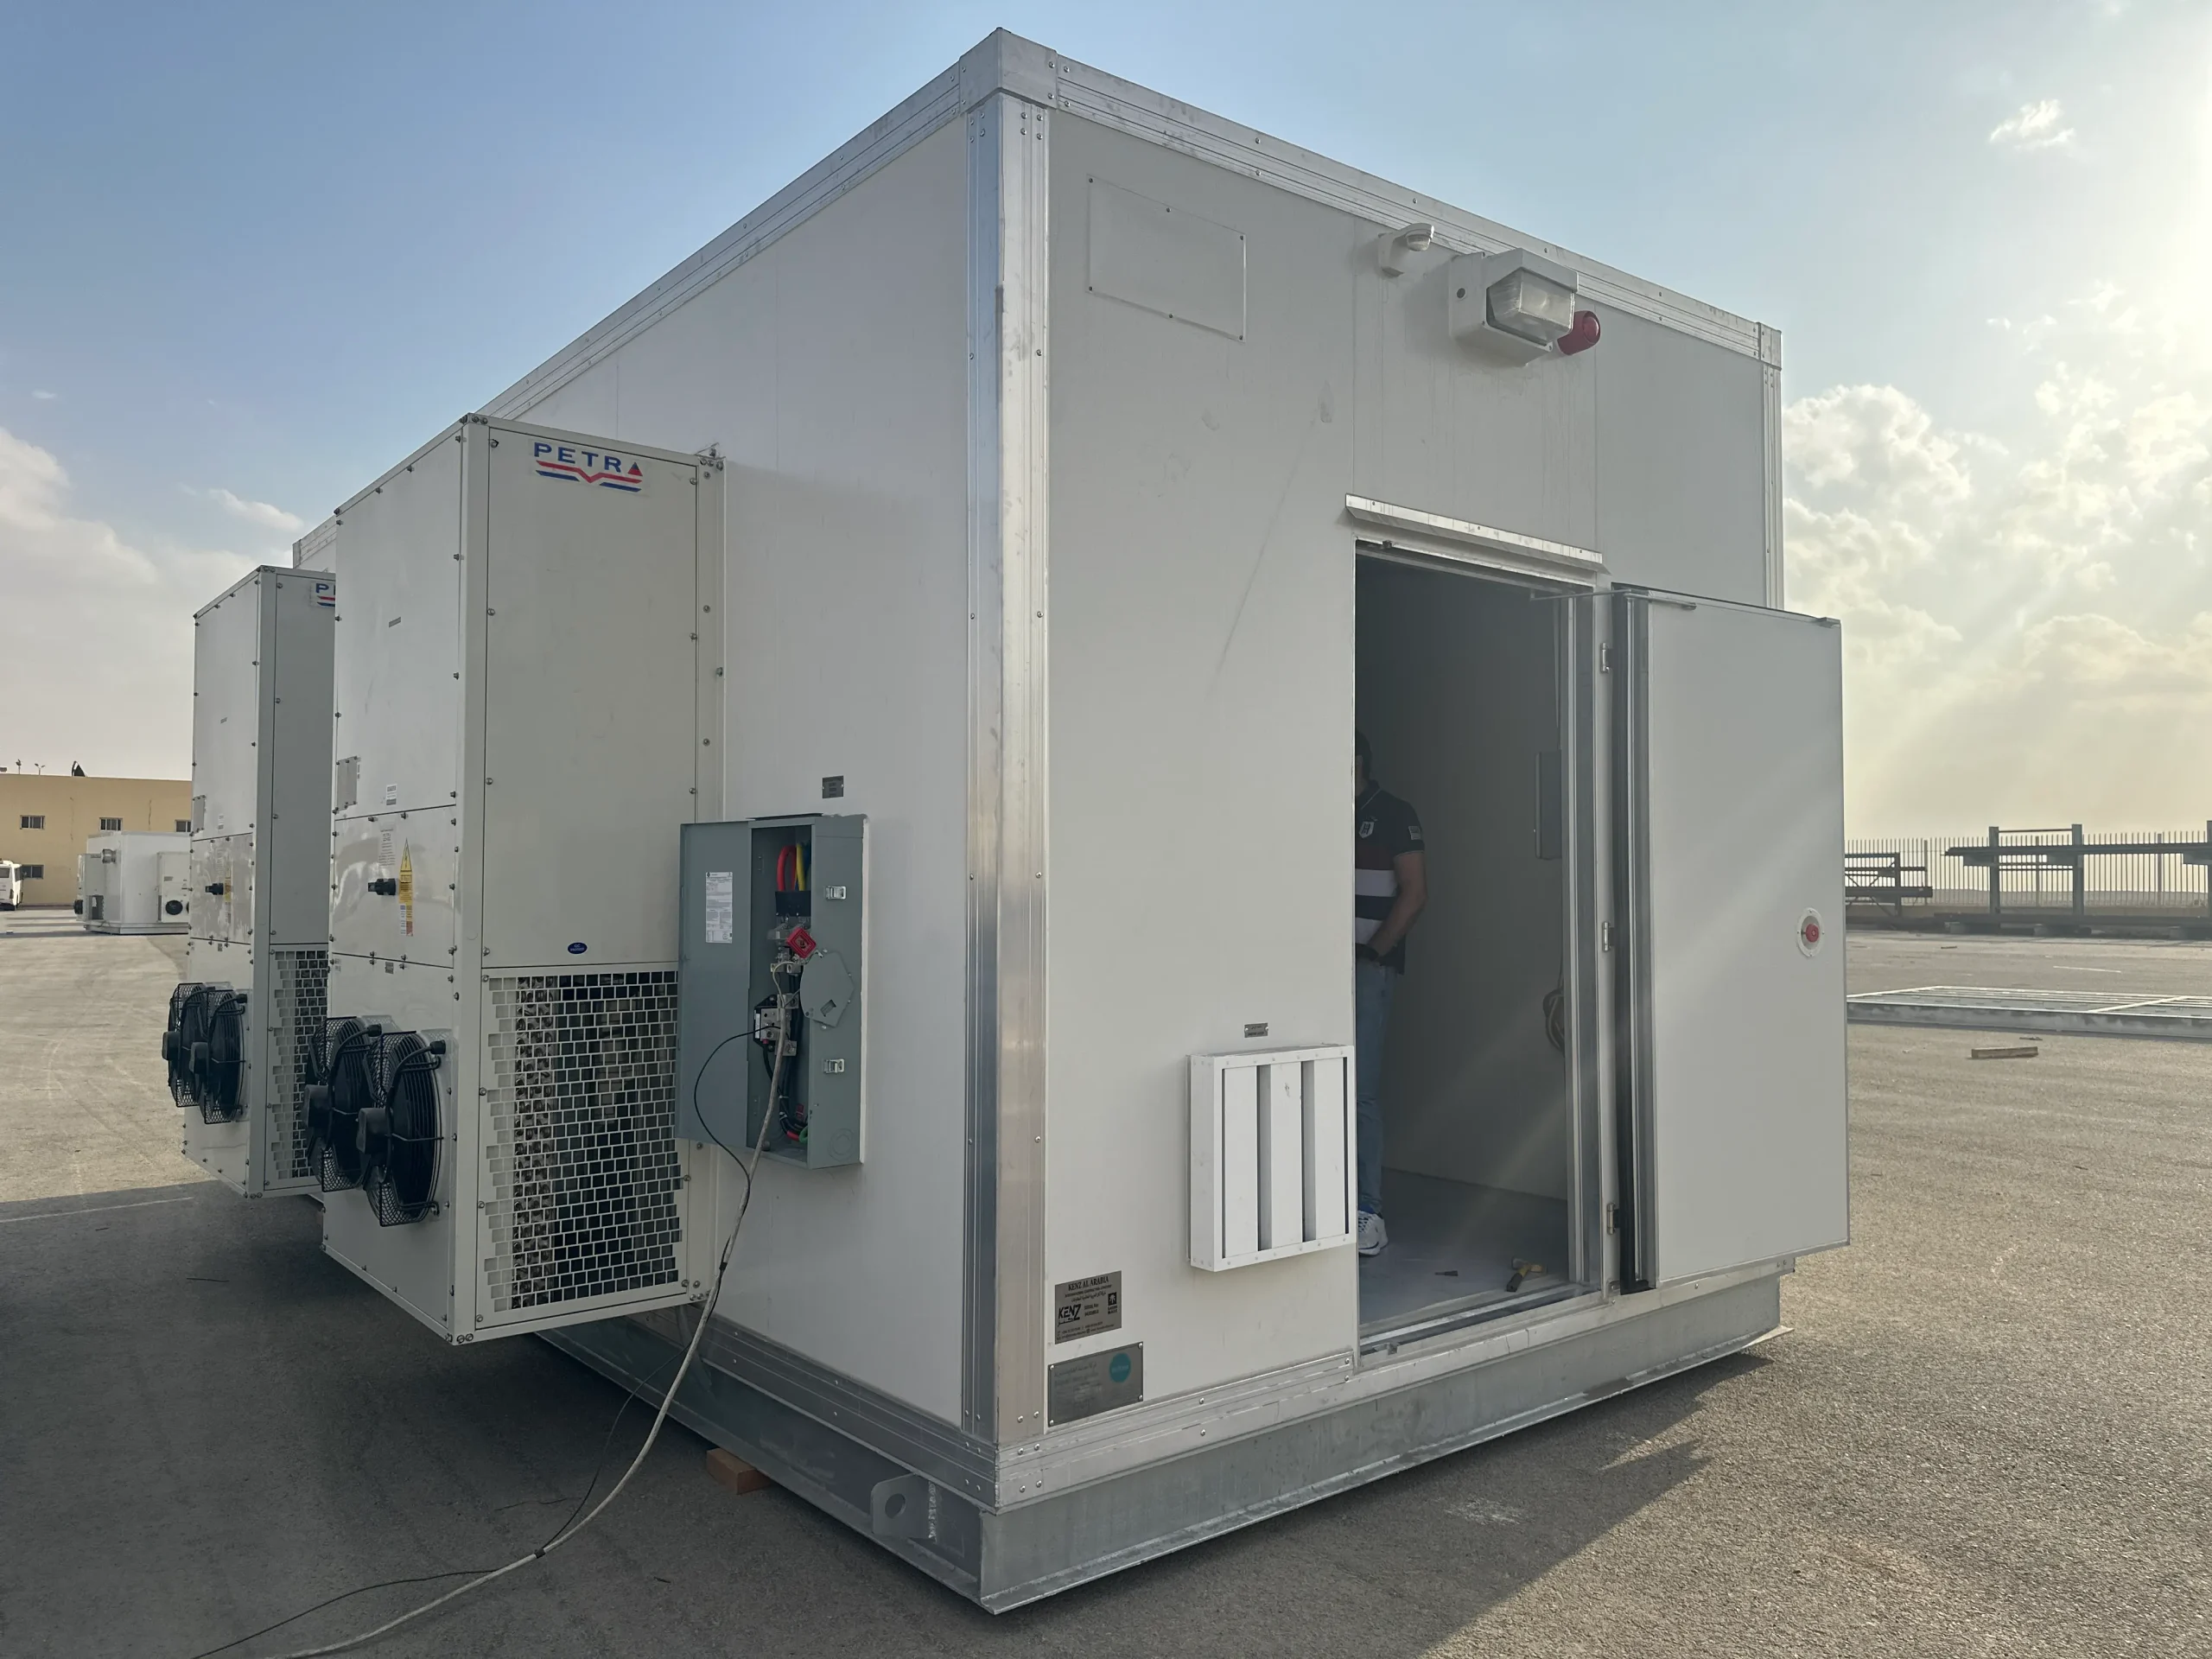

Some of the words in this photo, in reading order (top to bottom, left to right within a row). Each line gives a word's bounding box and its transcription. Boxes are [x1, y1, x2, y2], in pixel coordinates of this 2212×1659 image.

[1068, 1282, 1082, 1291] KENZ
[1090, 1276, 1109, 1286] ARABIA
[1058, 1304, 1081, 1320] KENZ
